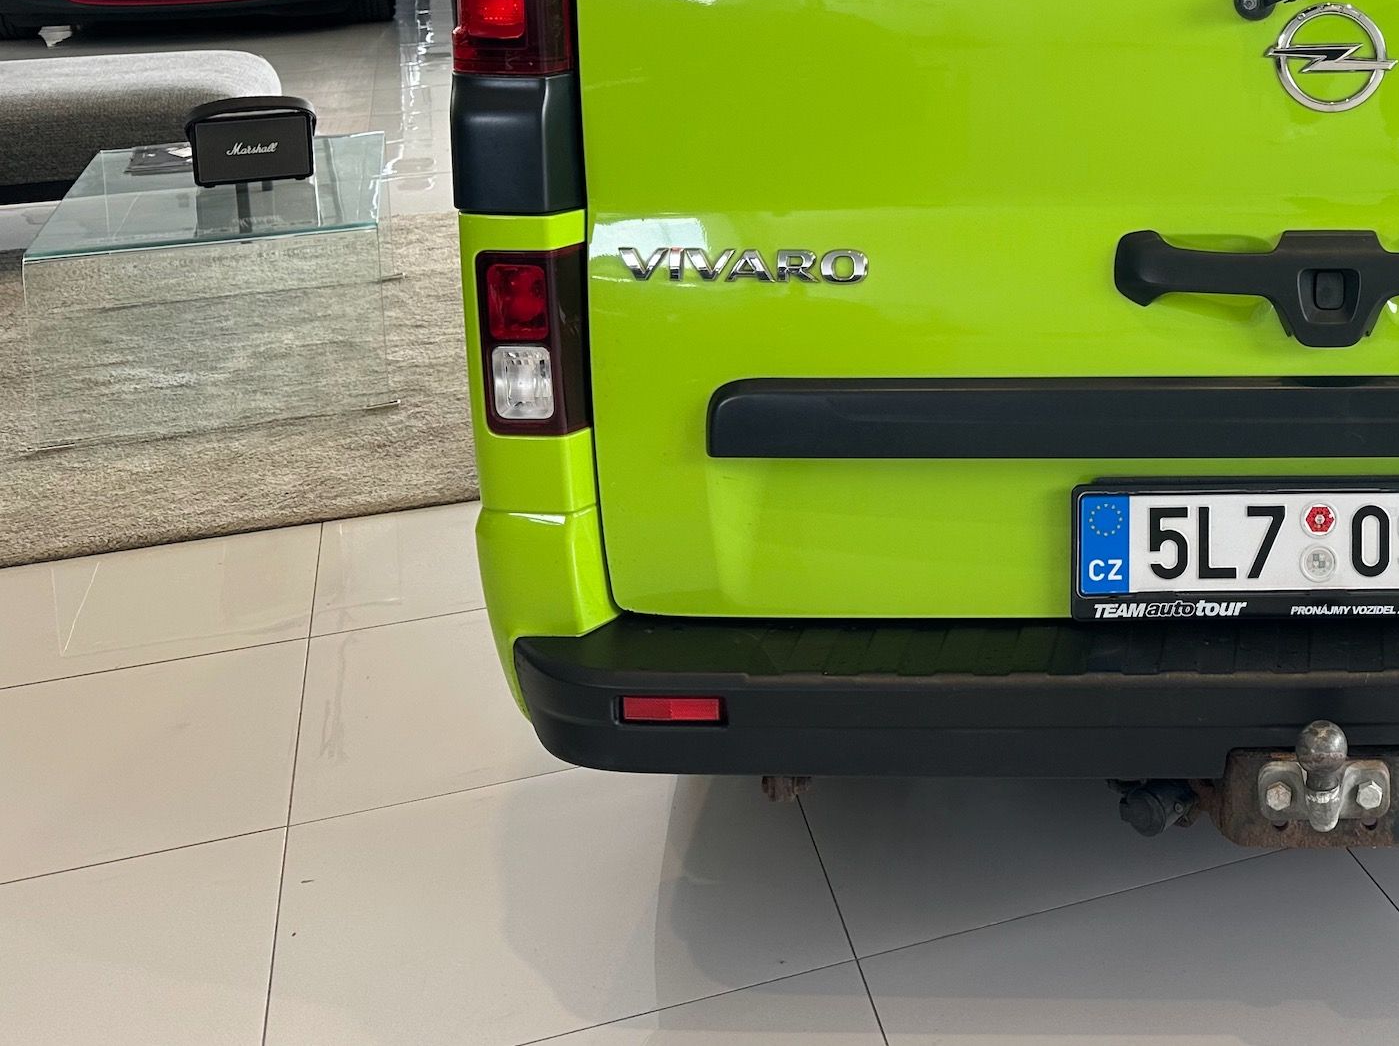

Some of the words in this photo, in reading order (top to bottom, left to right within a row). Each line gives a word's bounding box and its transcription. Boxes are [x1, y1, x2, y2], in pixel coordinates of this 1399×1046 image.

[226, 142, 278, 155] Marshall
[617, 246, 869, 284] VIVARO
[1146, 505, 1286, 579] 5L7
[1088, 559, 1123, 581] CZ
[1290, 604, 1351, 616] PRONÁJMY
[1352, 605, 1396, 615] VOZIDEL
